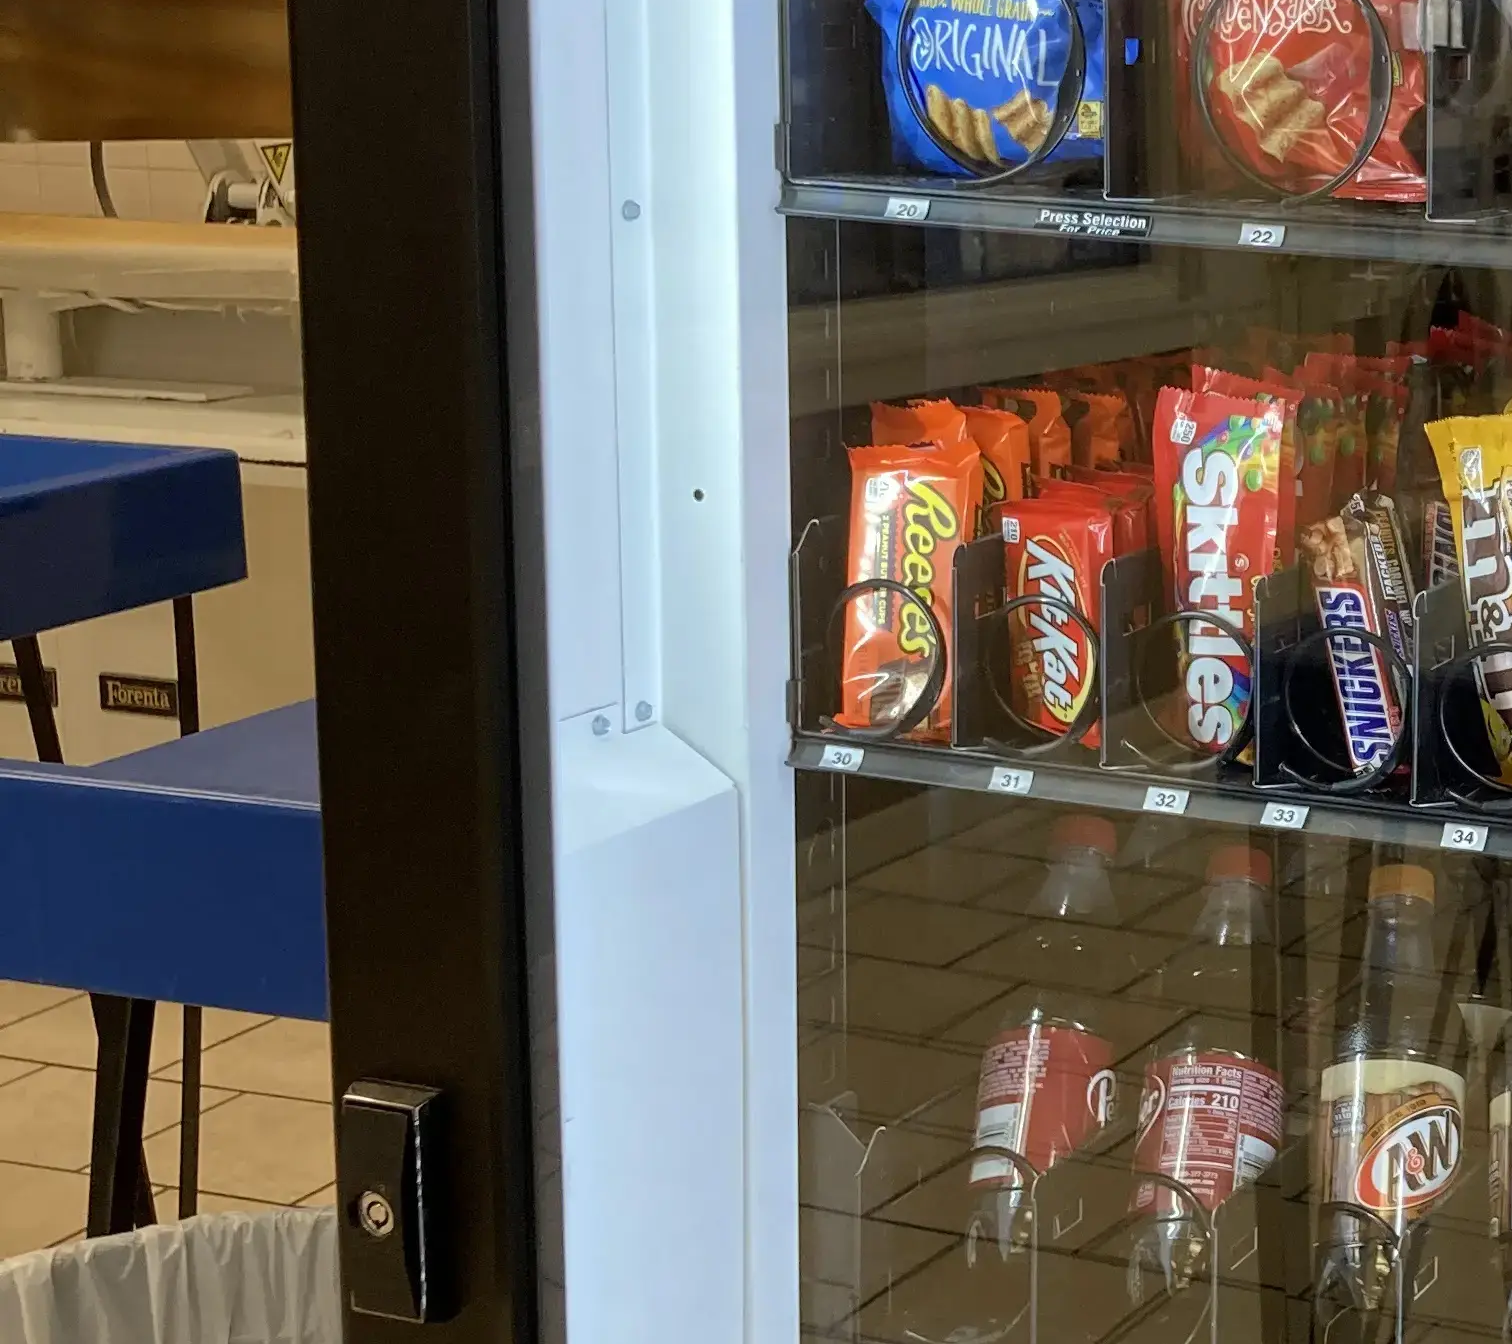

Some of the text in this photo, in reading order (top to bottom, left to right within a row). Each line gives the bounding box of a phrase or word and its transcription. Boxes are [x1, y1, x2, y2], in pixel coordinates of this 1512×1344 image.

[911, 16, 1060, 87] ORIGINAL
[896, 204, 918, 217] 20
[1040, 210, 1146, 229] Press Selection
[1249, 229, 1273, 245] 22
[1182, 423, 1196, 444] 250
[1183, 448, 1246, 744] Skittles
[1320, 590, 1393, 763] SNICKERS
[106, 680, 170, 710] Forenta
[832, 752, 853, 766] 30
[1000, 774, 1020, 788] 31
[1155, 793, 1176, 807] 32
[1274, 808, 1295, 822] 33
[1453, 830, 1474, 844] 34
[1172, 1065, 1242, 1078] Nutrition Facts
[1212, 1093, 1238, 1108] 210
[1387, 1109, 1453, 1204] A&W
